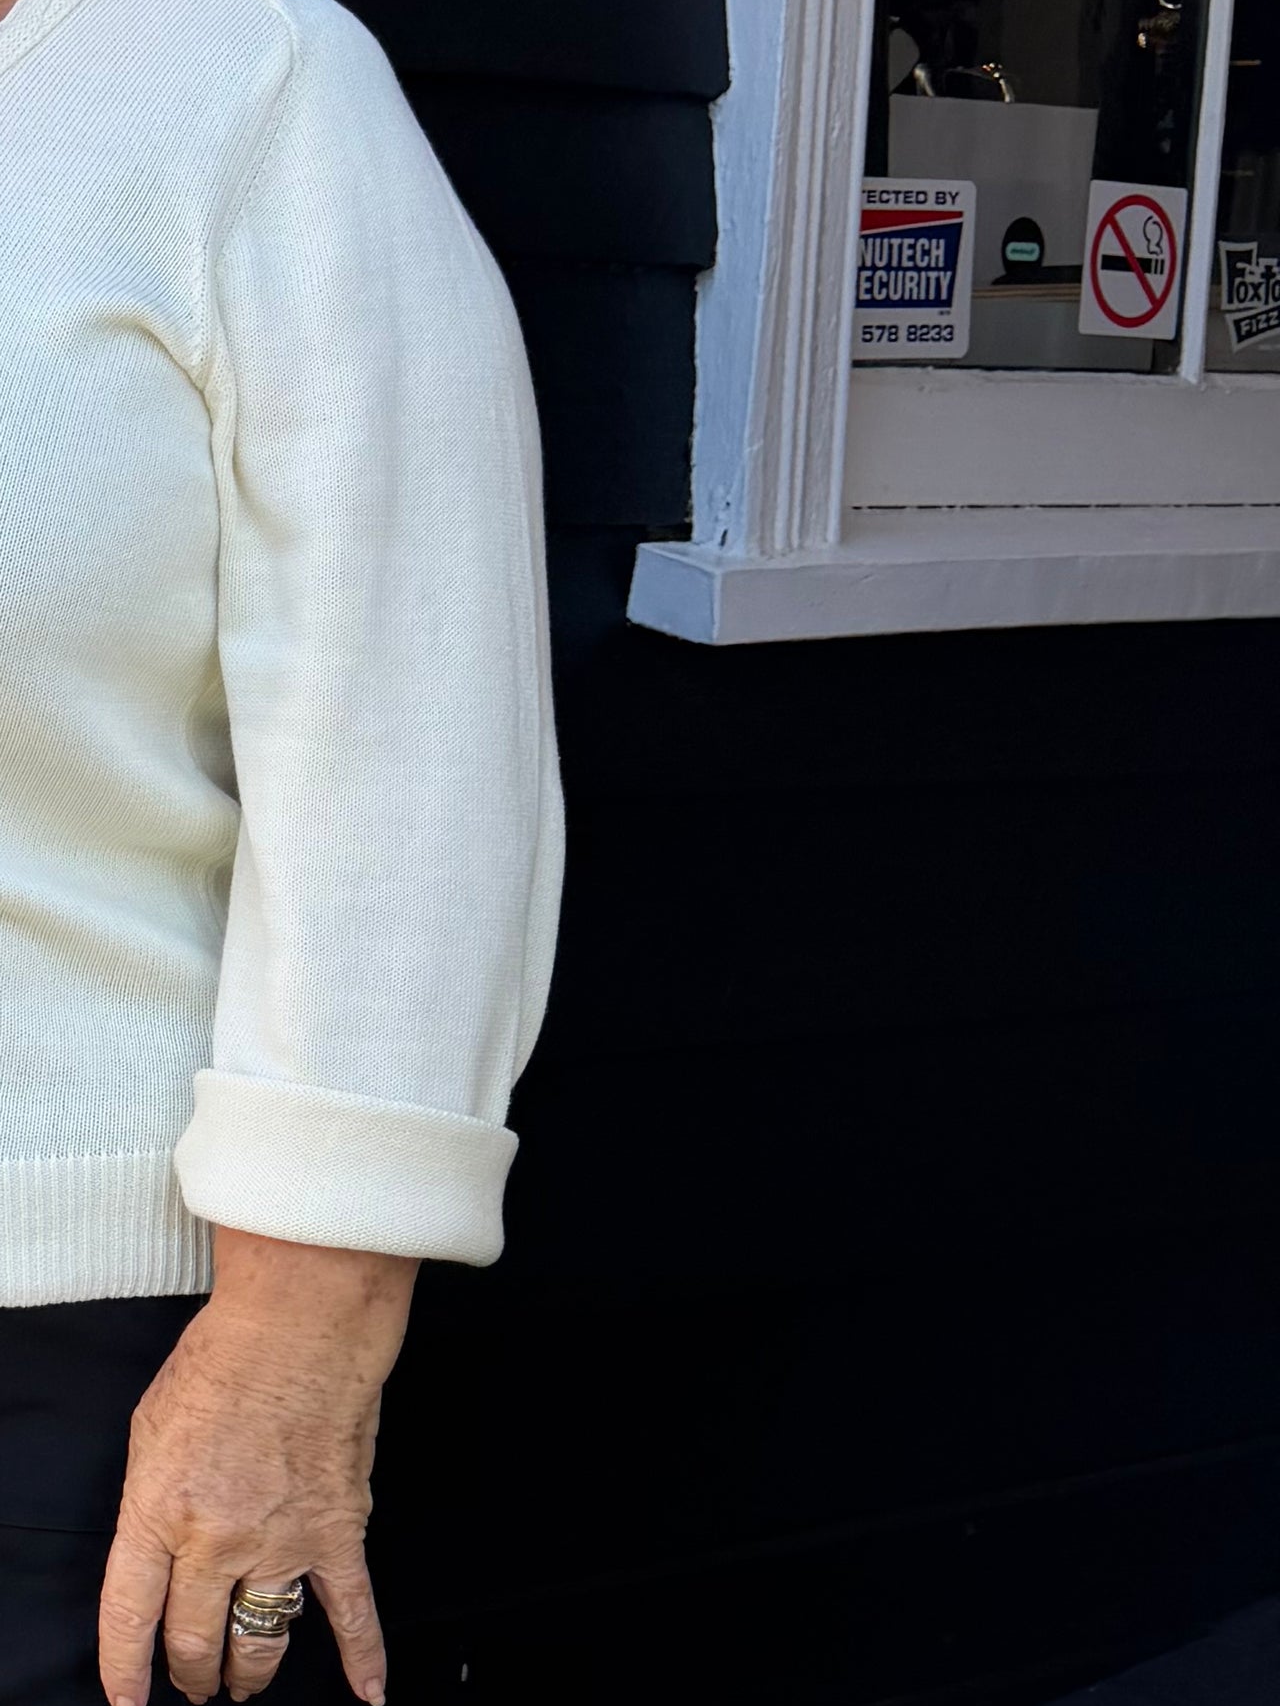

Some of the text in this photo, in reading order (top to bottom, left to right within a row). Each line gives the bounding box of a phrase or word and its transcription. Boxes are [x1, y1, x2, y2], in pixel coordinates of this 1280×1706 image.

[862, 189, 960, 205] ECTED BY
[857, 237, 946, 268] NUTECH
[857, 269, 953, 301] ECURITY
[861, 324, 955, 343] 578 8233
[1239, 310, 1280, 336] FIZZ
